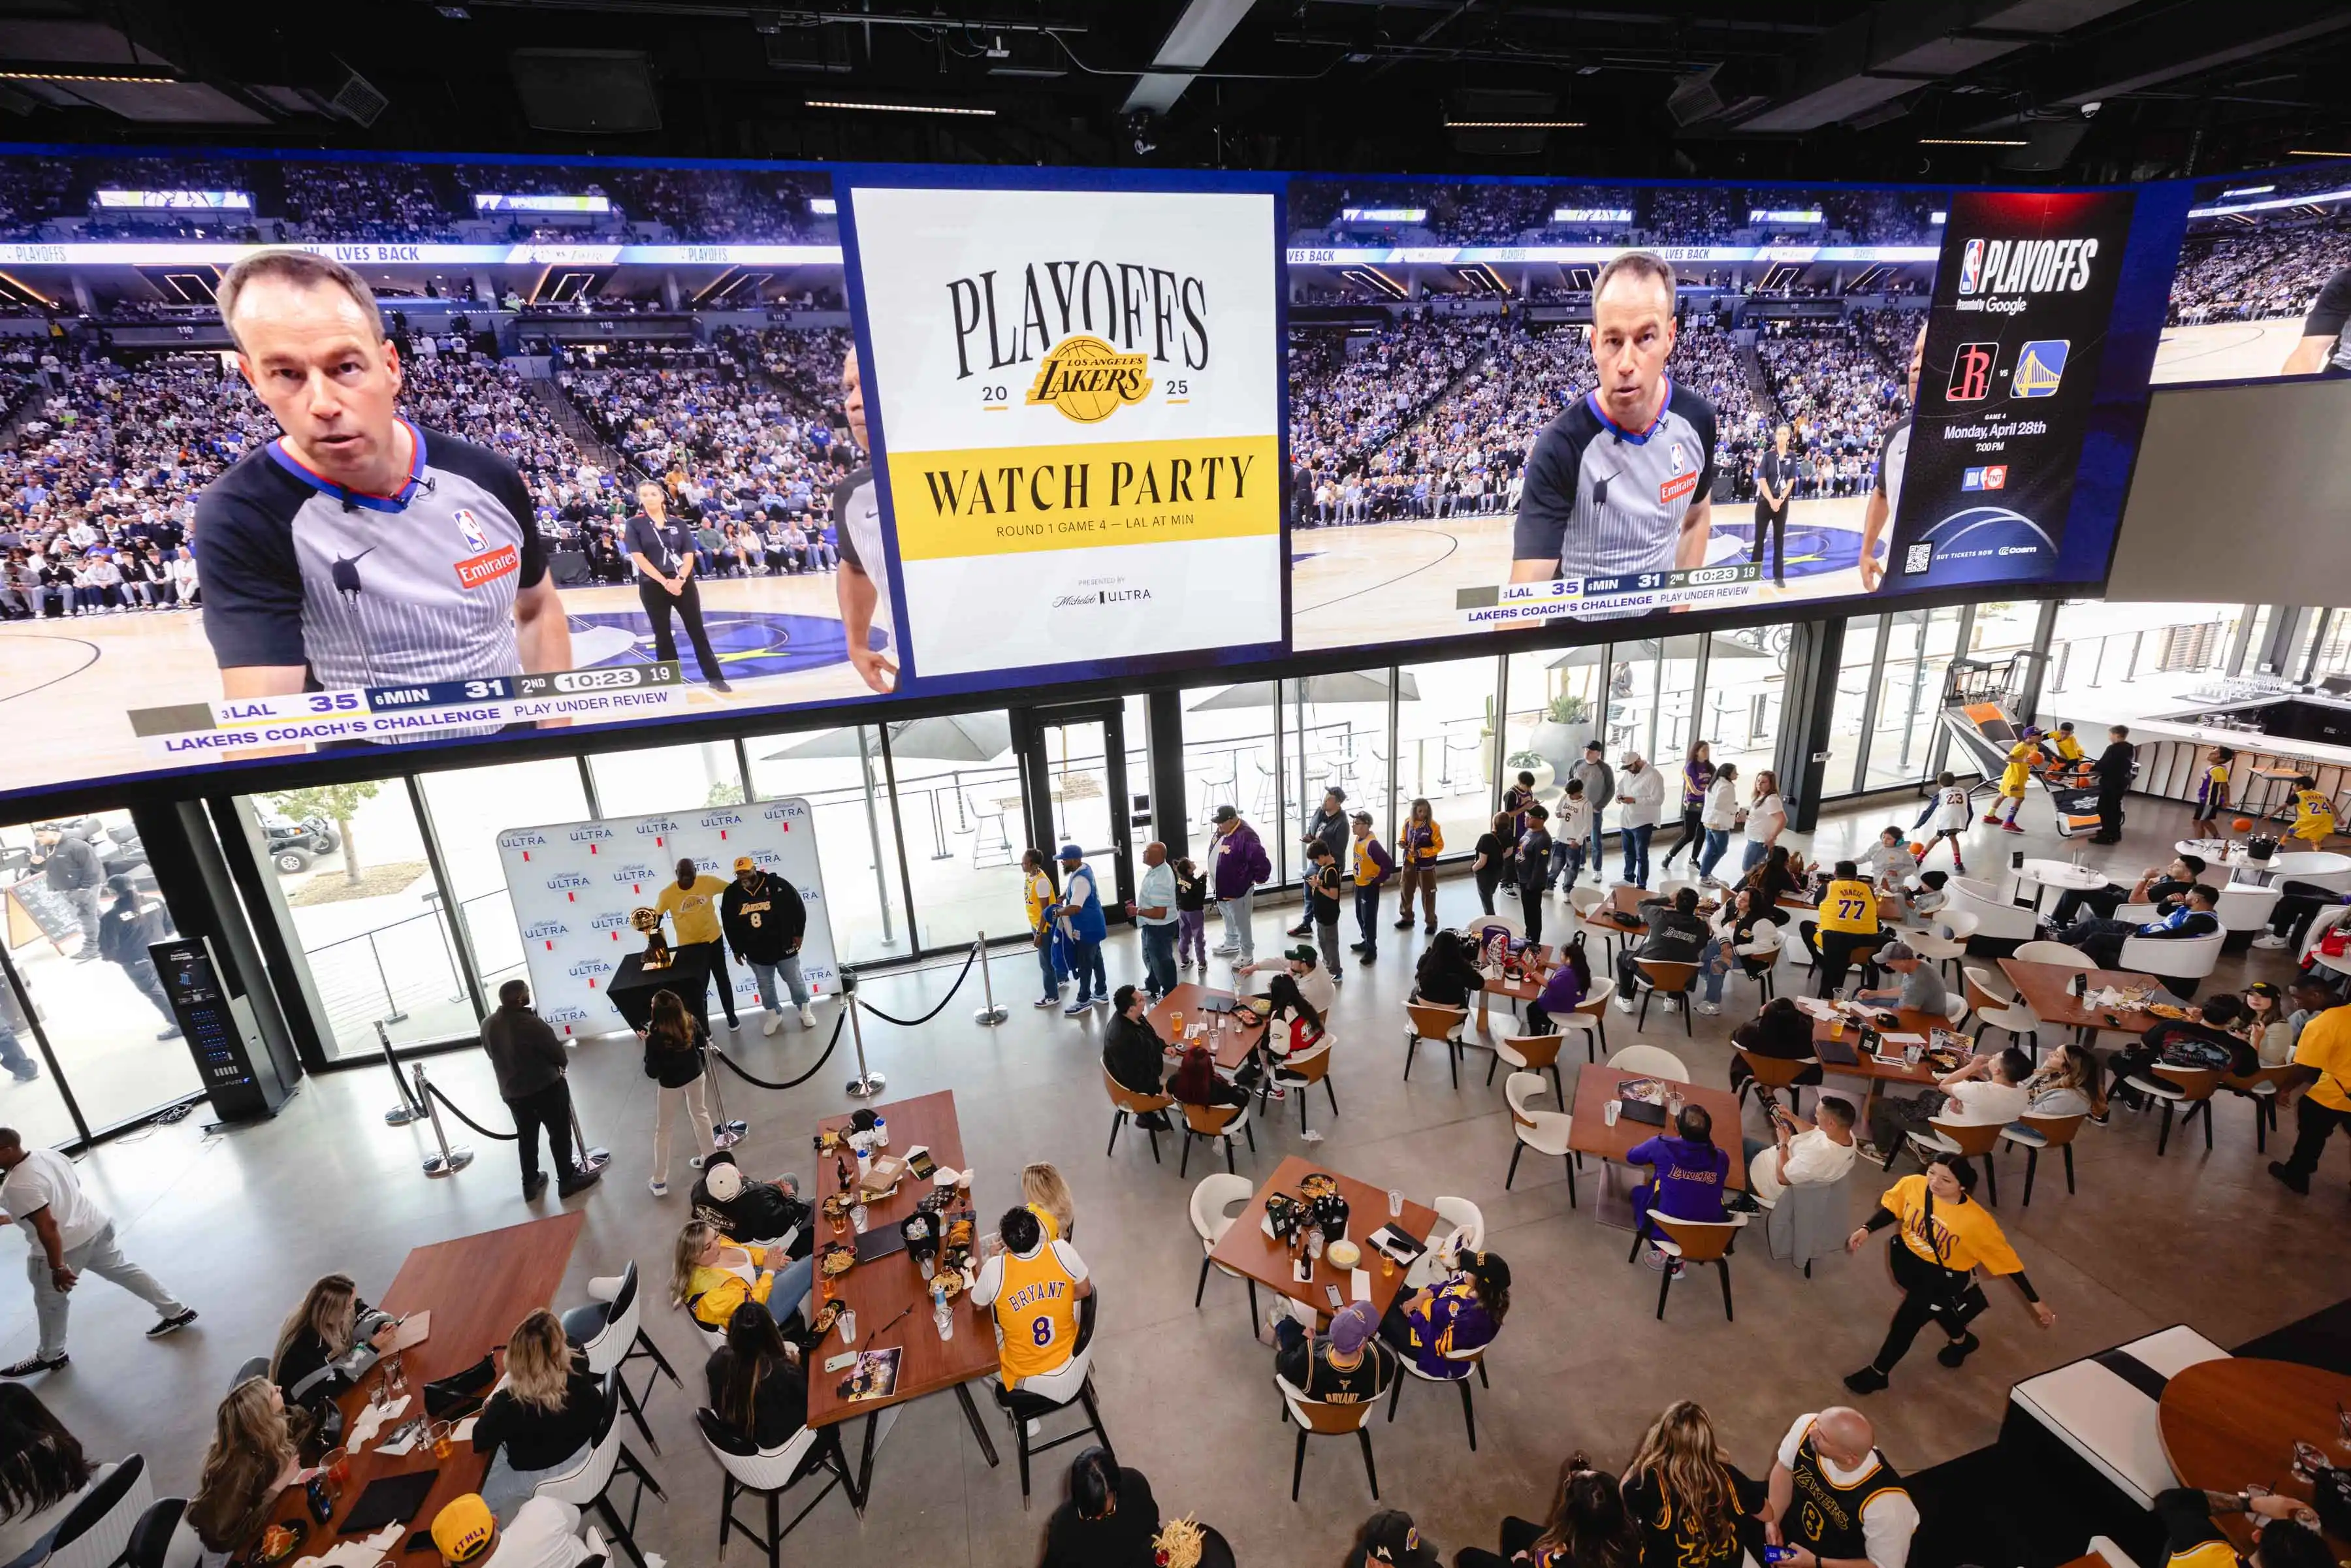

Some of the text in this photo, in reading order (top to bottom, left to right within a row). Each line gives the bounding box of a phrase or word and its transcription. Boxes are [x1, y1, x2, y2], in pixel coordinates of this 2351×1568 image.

[16, 246, 66, 261] PLAYOFFS
[377, 247, 420, 260] BACK
[688, 248, 728, 261] PLAYOFFS
[1309, 251, 1335, 261] BACK
[1687, 249, 1710, 259] BACK
[1978, 238, 2099, 293] PLAYOFFS
[1986, 296, 2026, 316] Google
[946, 260, 1209, 380] PLAYOFFS
[1090, 357, 1143, 366] ANGELES
[1031, 360, 1148, 400] LAKERS
[1166, 380, 1188, 394] 25
[982, 386, 1008, 401] 20
[1944, 421, 2047, 440] Monday, April 28th
[1975, 441, 2004, 453] 7:00 PM
[1989, 473, 2003, 483] TNT
[923, 455, 1255, 517] WATCH PARTY
[1661, 476, 1697, 498] Emirates
[997, 524, 1044, 537] ROUND
[1049, 523, 1053, 534] 1
[1058, 520, 1095, 532] GAME
[1099, 519, 1106, 530] 4
[1126, 517, 1149, 528] LAL
[1152, 516, 1167, 526] AT
[1171, 514, 1194, 524] MIN
[459, 552, 517, 583] Emirates
[1078, 577, 1115, 586] PRESENTED
[1509, 588, 1534, 598] LAL
[1551, 581, 1579, 596] 35
[1593, 579, 1619, 591] MIN
[1638, 573, 1661, 587] 31
[1669, 573, 1685, 585] 2ND
[1695, 570, 1735, 581] 10:23
[1742, 567, 1755, 578] 19
[1052, 588, 1151, 608] Michelob ULTRA
[1468, 586, 1750, 621] LAKERS COACH'S CHALLENGE PLAY UNDER REVIEW
[222, 667, 671, 719] 3 LAL 35 6 MIN 31 2ND 10:23 19
[165, 692, 668, 752] LAKERS COACH'S CHALLENGE PLAY UNDER REVIEW
[1946, 793, 1964, 805] 23
[764, 807, 805, 820] ULTRA
[2308, 802, 2331, 815] 24
[701, 815, 743, 827] ULTRA
[1565, 812, 1571, 822] 6
[570, 829, 614, 841] ULTRA
[636, 822, 679, 834] ULTRA
[502, 836, 547, 848] ULTRA
[696, 861, 719, 872] TRA
[753, 854, 781, 865] LTRA
[614, 870, 656, 882] ULTRA
[547, 878, 590, 889] ULTRA
[1838, 899, 1866, 920] 77
[751, 912, 762, 929] 8
[525, 925, 569, 938] ULTRA
[1661, 926, 1697, 944] LAKERS
[569, 963, 611, 976] ULTRA
[804, 970, 833, 981] LTRA
[736, 982, 758, 993] ULT
[545, 1010, 588, 1024] ULTRA
[1667, 1164, 1717, 1185] LAKERS
[1910, 1209, 1960, 1260] LAERS
[1008, 1281, 1065, 1313] BRYANT
[1031, 1315, 1055, 1347] 8
[1792, 1464, 1849, 1531] LAKERS
[1802, 1501, 1825, 1541] 8
